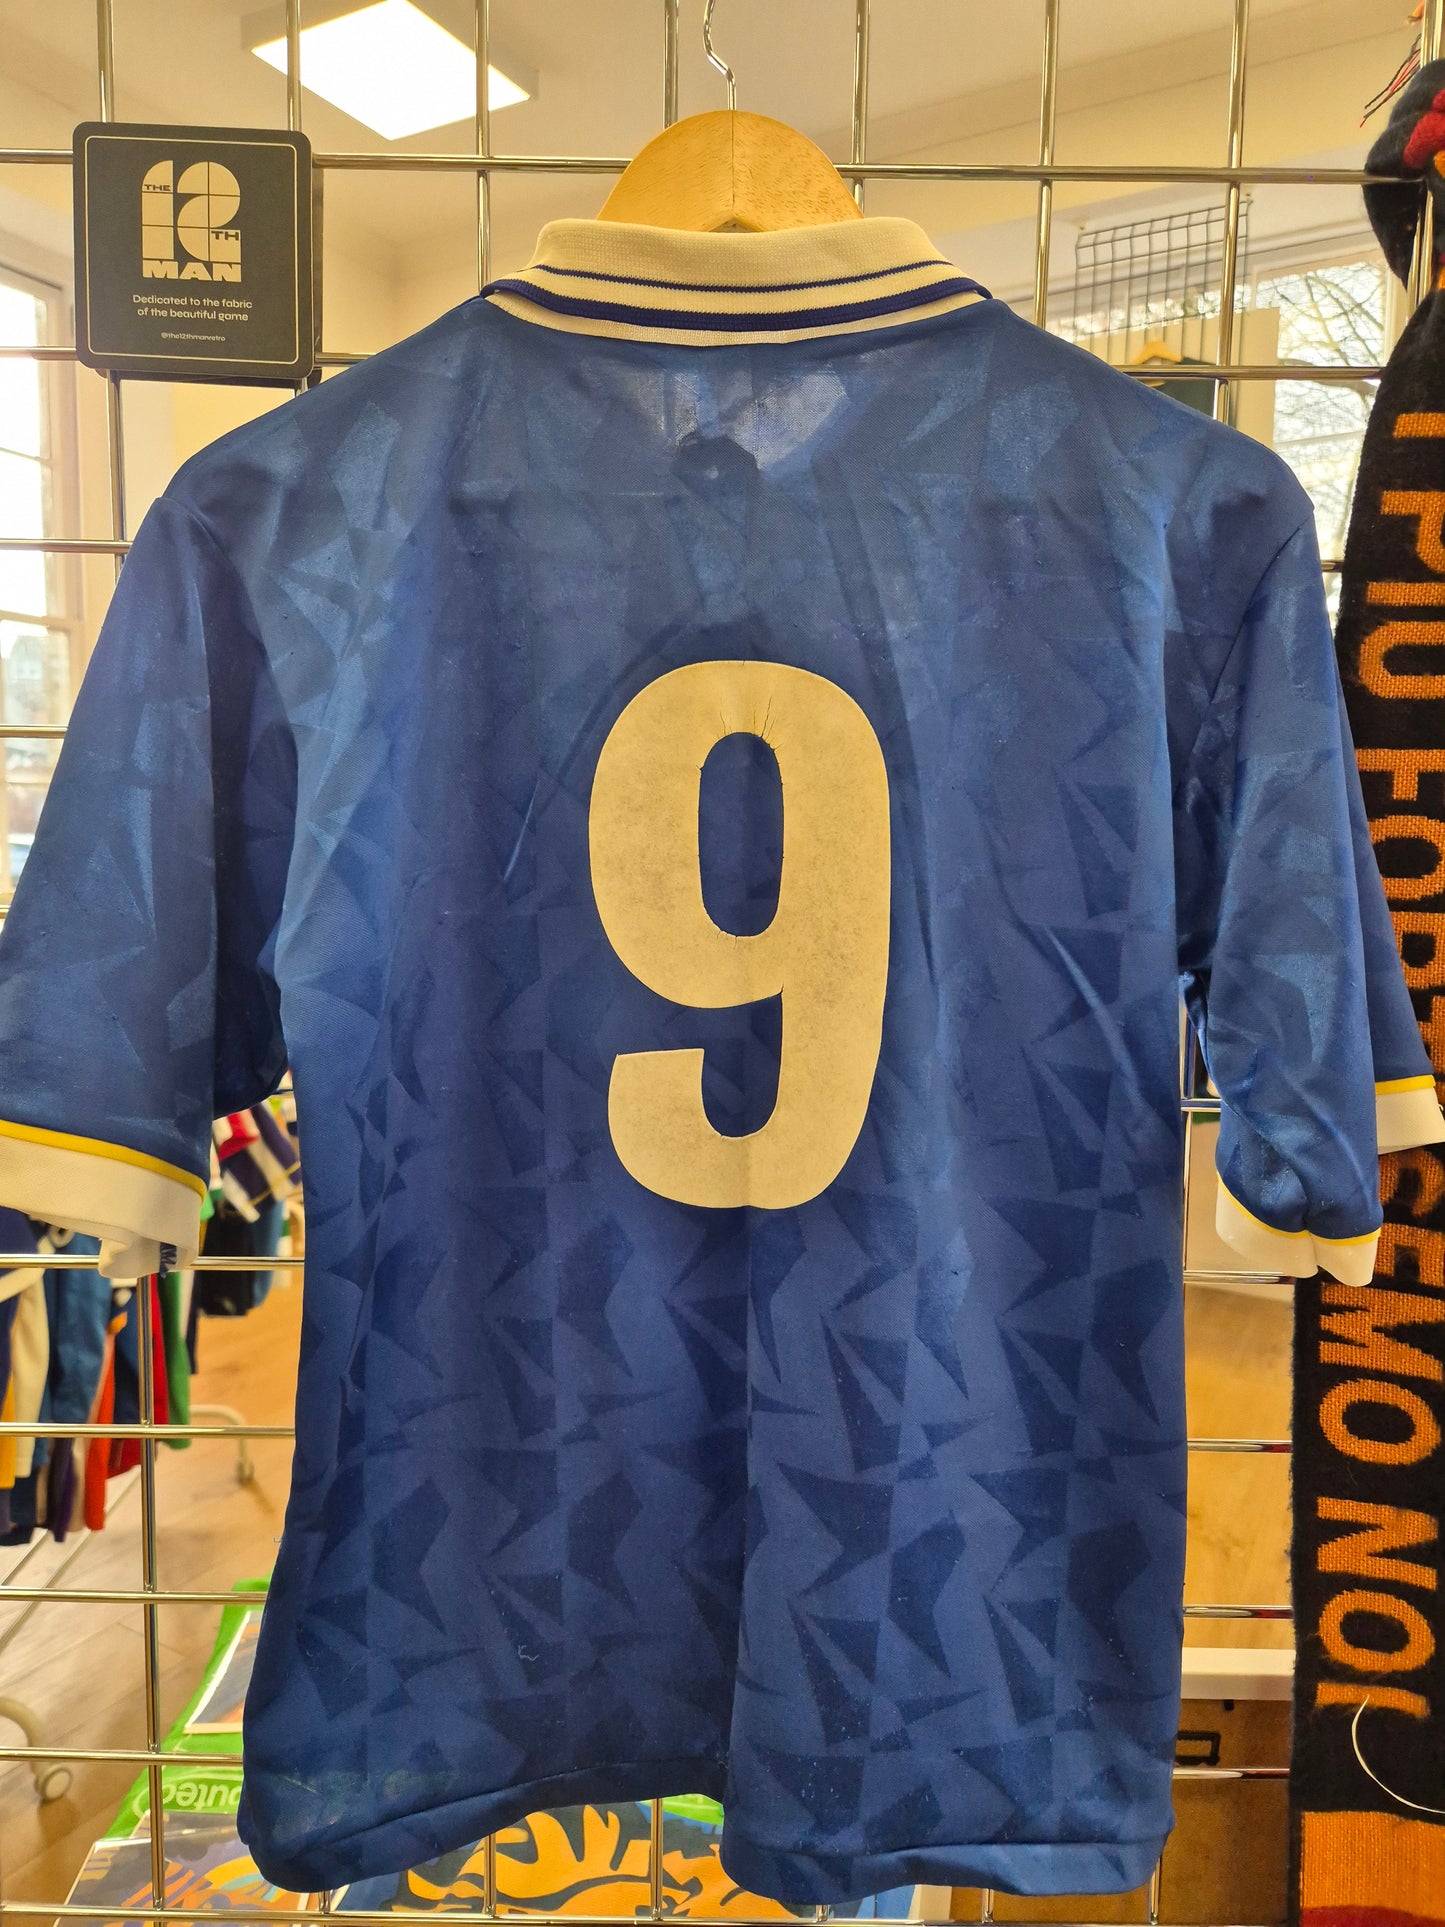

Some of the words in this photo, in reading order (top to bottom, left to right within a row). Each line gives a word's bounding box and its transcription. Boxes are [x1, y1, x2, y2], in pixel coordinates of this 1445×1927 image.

[143, 184, 171, 192] THE
[211, 231, 240, 241] TH
[142, 260, 242, 282] MAN
[132, 294, 187, 306] Dedicated
[189, 297, 201, 306] to
[203, 298, 220, 307] the
[222, 299, 253, 309] fabric
[137, 307, 149, 316] of
[150, 308, 168, 317] the
[170, 309, 216, 320] beautiful
[218, 313, 249, 322] game
[161, 332, 226, 342] @the12thmanretro
[588, 660, 891, 1210] 9
[1316, 1495, 1440, 1719] NOI
